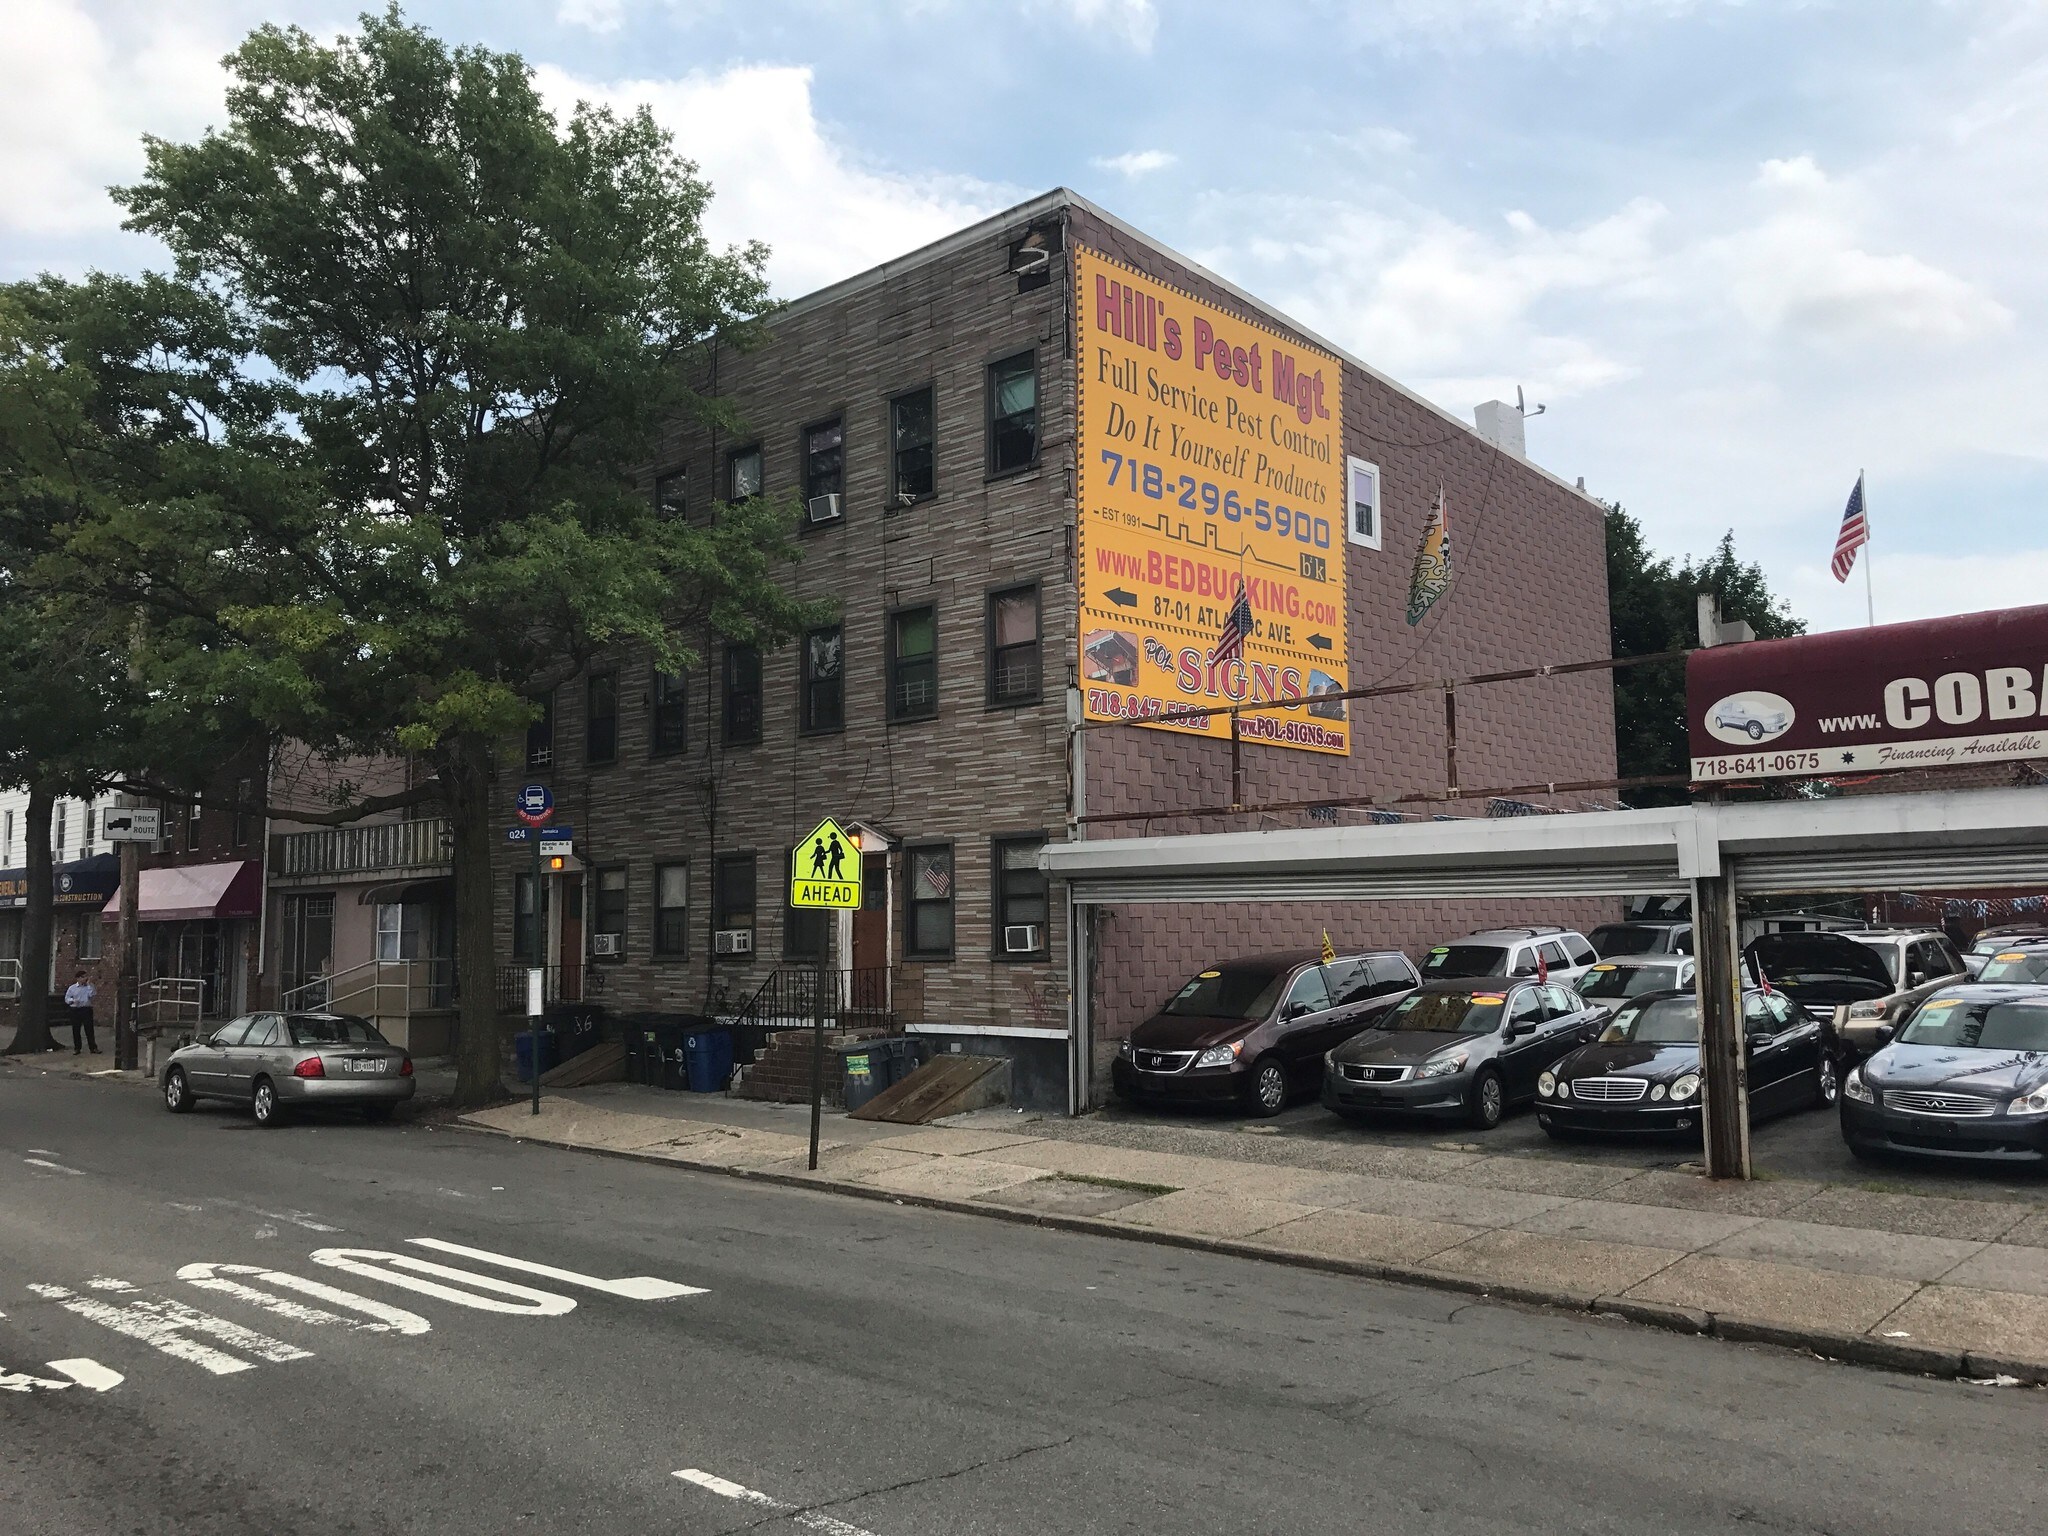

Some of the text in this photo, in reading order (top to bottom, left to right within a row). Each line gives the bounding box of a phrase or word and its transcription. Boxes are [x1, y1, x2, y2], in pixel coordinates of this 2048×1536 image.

[1096, 273, 1330, 425] Hill's Pest Mgt.
[1097, 346, 1331, 465] Full Service Pest Control
[1105, 401, 1327, 505] Do It Yourself Products
[1101, 449, 1330, 550] 718-296-5900
[1102, 506, 1140, 529] EST 1991
[1154, 596, 1296, 646] 87-01 ATLAC AVE.
[1144, 636, 1176, 674] POL
[1817, 664, 2048, 733] www.COB
[1696, 735, 2041, 777] 718-641-0675 Financing Available
[133, 826, 156, 834] ROUTE
[134, 815, 156, 823] TRUCK
[509, 829, 526, 839] Q24
[519, 809, 551, 821] NO STANDING
[60, 893, 103, 902] CONSTRUCTION
[801, 885, 852, 903] AHEAD
